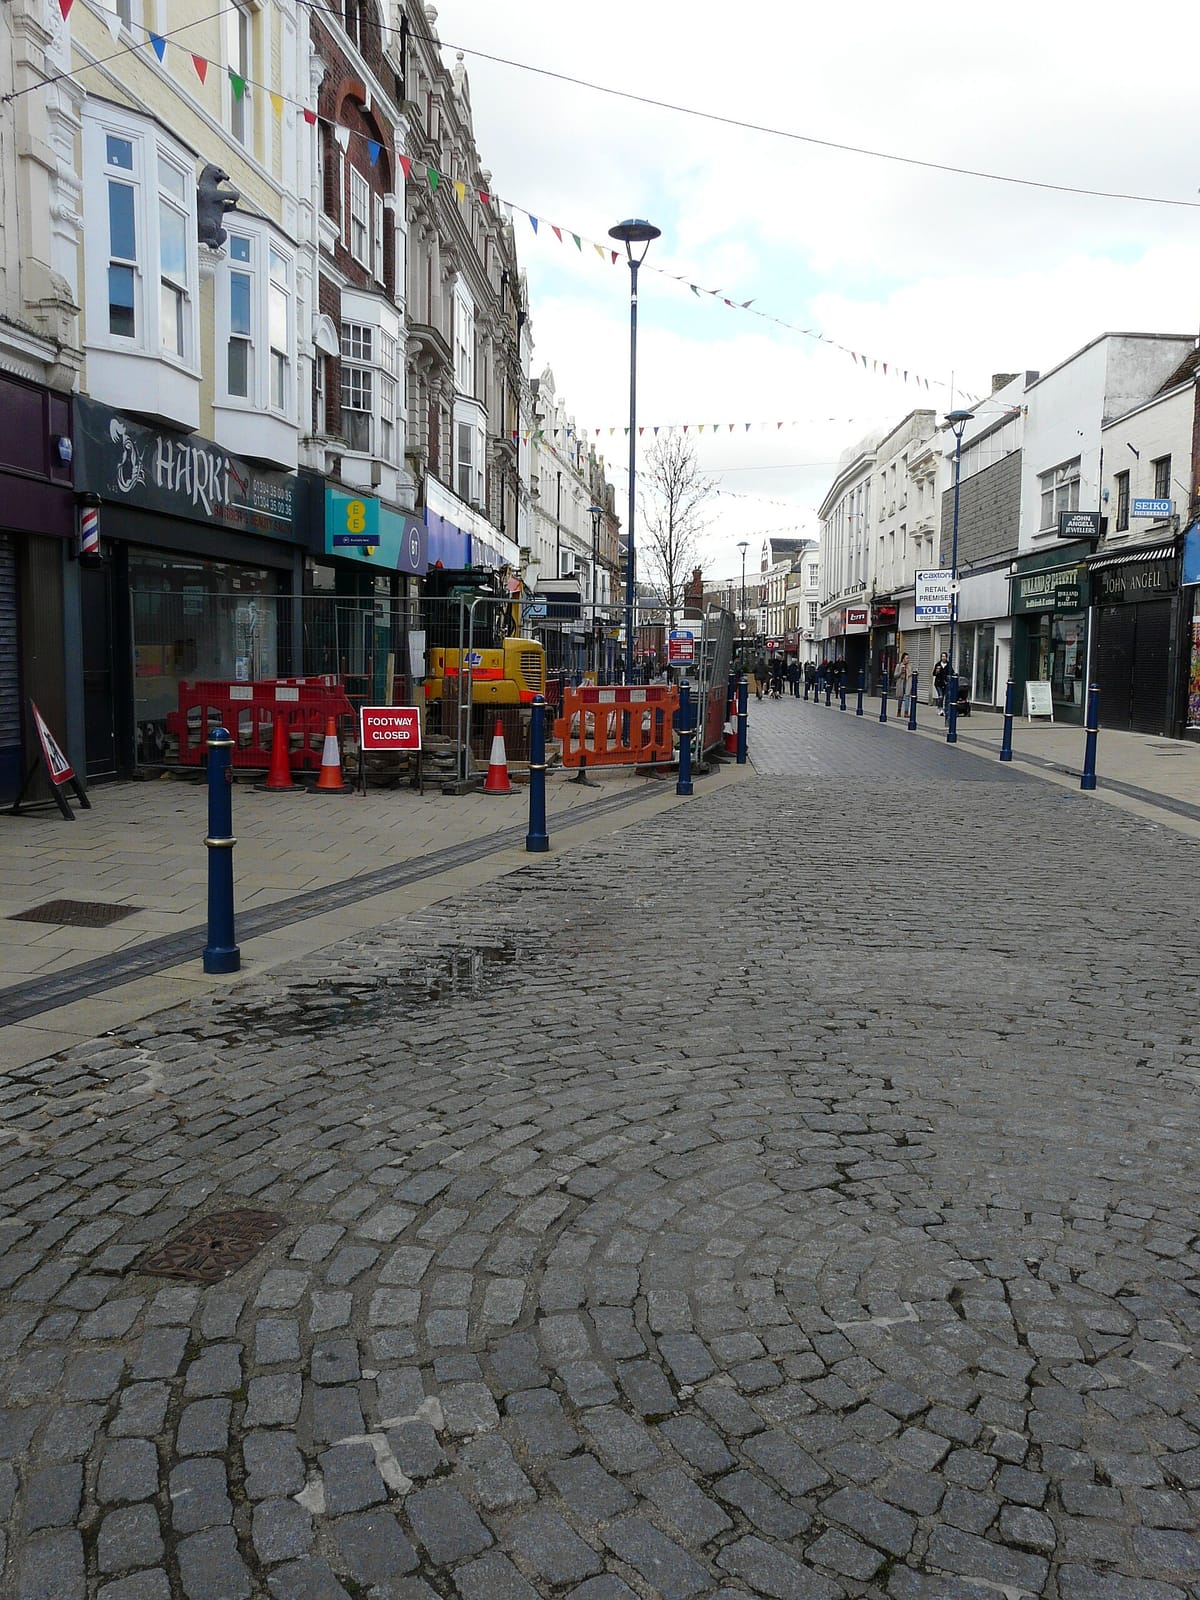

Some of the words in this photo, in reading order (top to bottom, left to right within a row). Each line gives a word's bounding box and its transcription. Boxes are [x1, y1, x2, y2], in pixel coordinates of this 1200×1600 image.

[1135, 501, 1169, 511] SEIKO
[1067, 520, 1095, 528] ANGELL
[1104, 577, 1127, 594] JOHN
[1129, 570, 1161, 590] ANGELL
[922, 606, 933, 614] TO
[935, 606, 949, 614] LET
[367, 717, 413, 726] FOOTWAY
[372, 731, 410, 740] CLOSED
